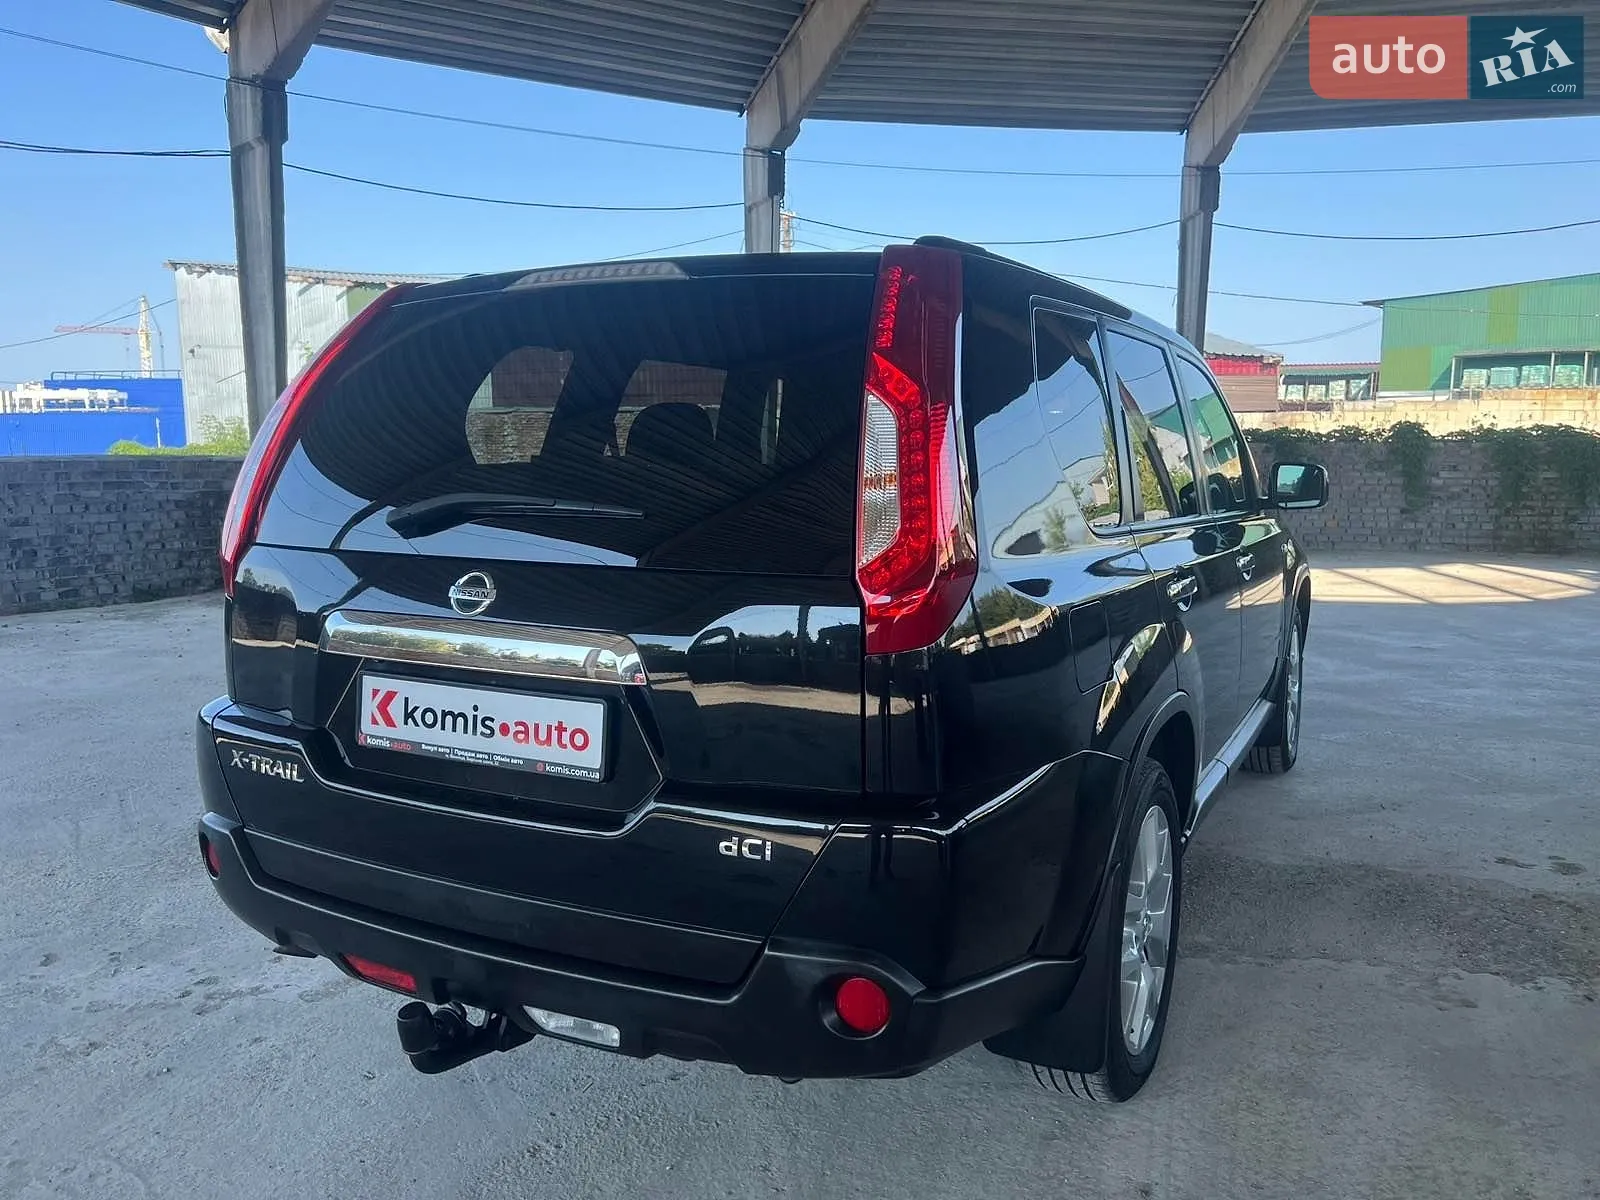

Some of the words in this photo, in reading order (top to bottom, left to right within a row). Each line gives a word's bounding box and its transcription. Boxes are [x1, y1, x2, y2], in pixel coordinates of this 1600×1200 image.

[452, 588, 489, 599] NISSAN
[230, 749, 304, 783] X-TRAIL
[545, 763, 600, 779] komis.com.ua
